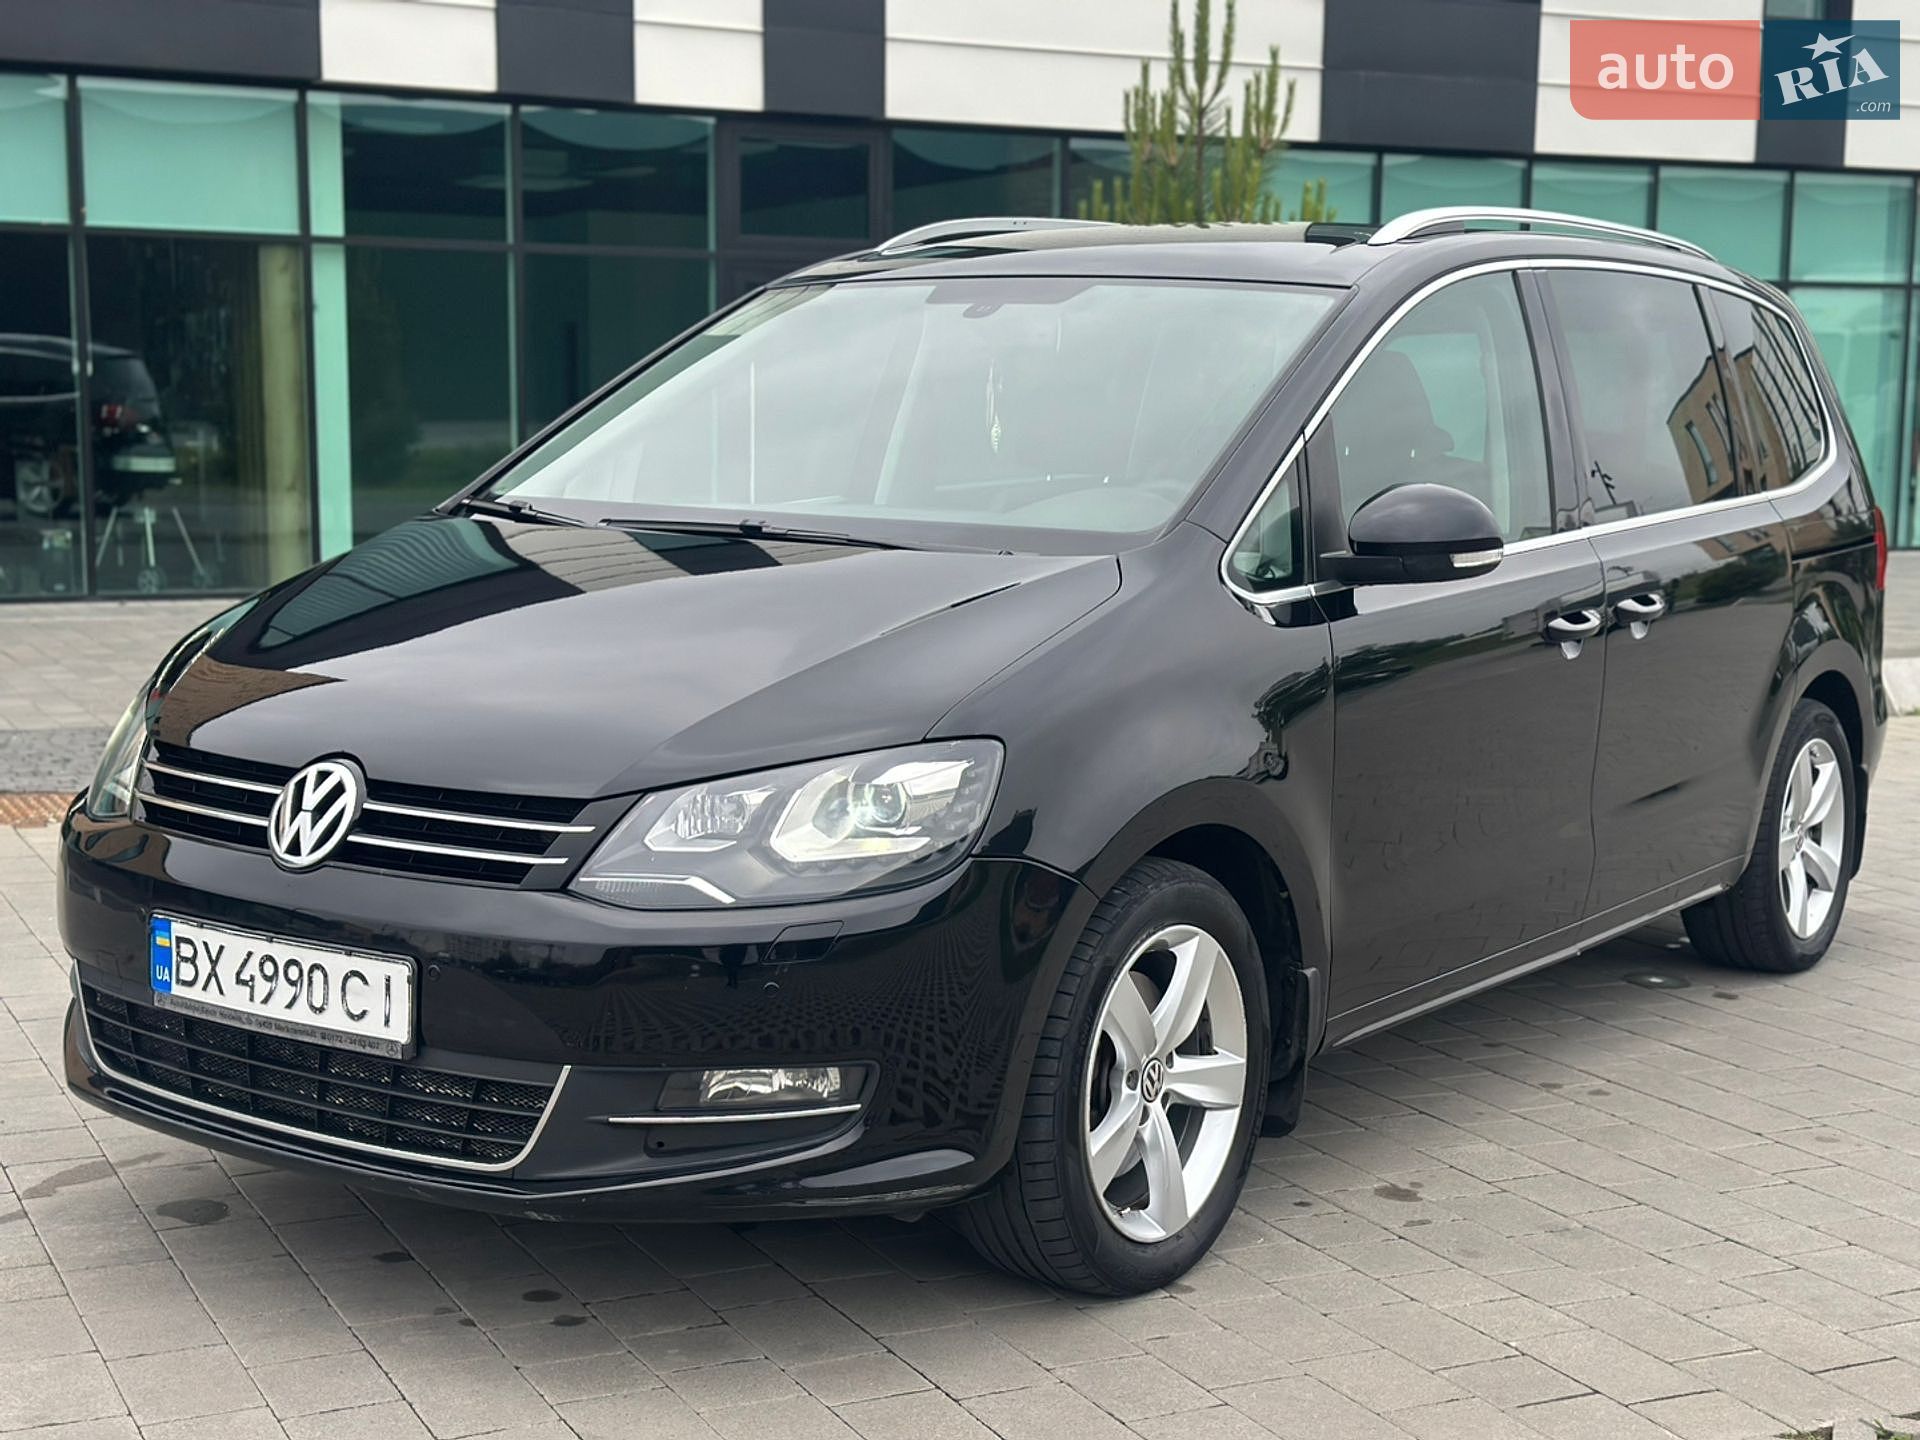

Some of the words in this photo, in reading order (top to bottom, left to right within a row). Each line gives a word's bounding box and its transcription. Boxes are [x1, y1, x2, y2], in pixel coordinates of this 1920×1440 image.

[269, 763, 355, 865] VW
[156, 965, 170, 982] UA
[175, 936, 225, 996] BX
[235, 950, 329, 1015] 4990
[340, 969, 391, 1028] CI
